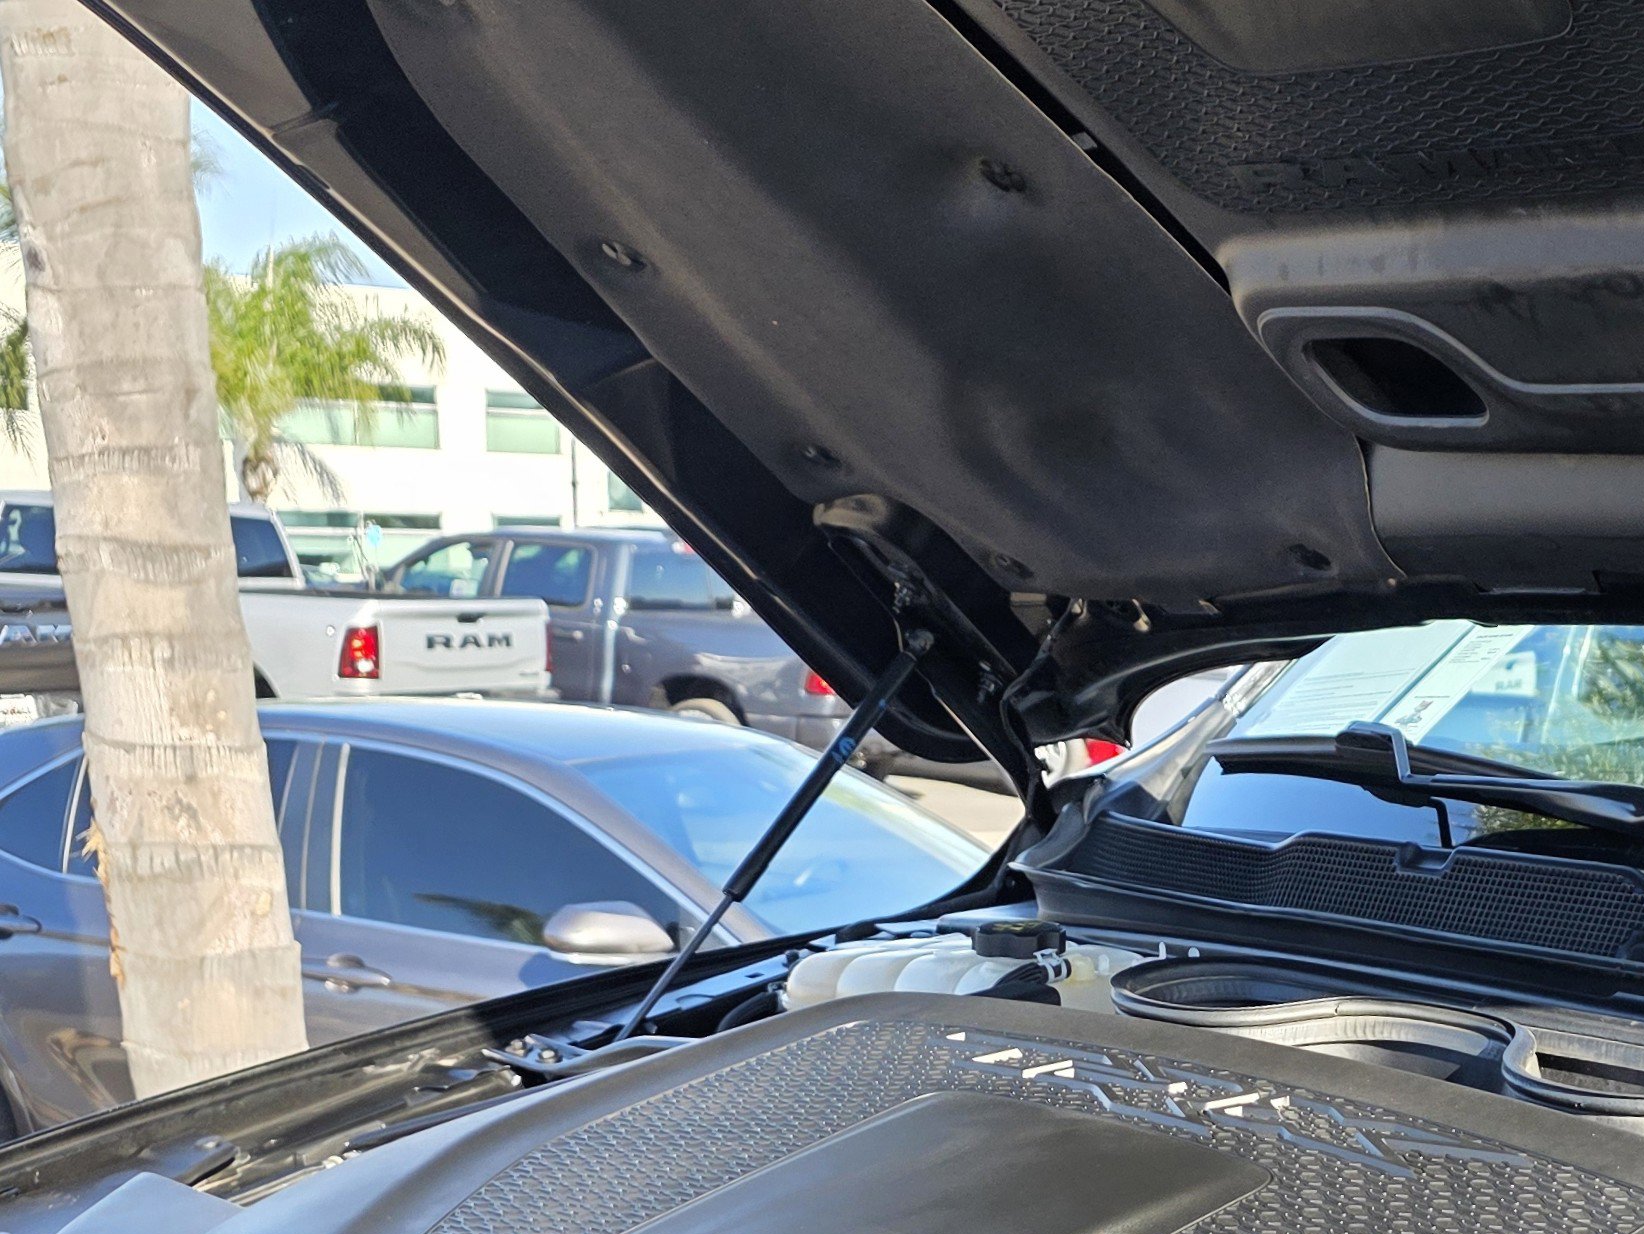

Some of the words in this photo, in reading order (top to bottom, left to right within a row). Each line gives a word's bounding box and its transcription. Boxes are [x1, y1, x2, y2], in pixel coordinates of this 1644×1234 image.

[1229, 150, 1491, 193] RAM
[0, 624, 74, 645] AM
[426, 634, 512, 649] RAM
[922, 1029, 1537, 1180] TRX
